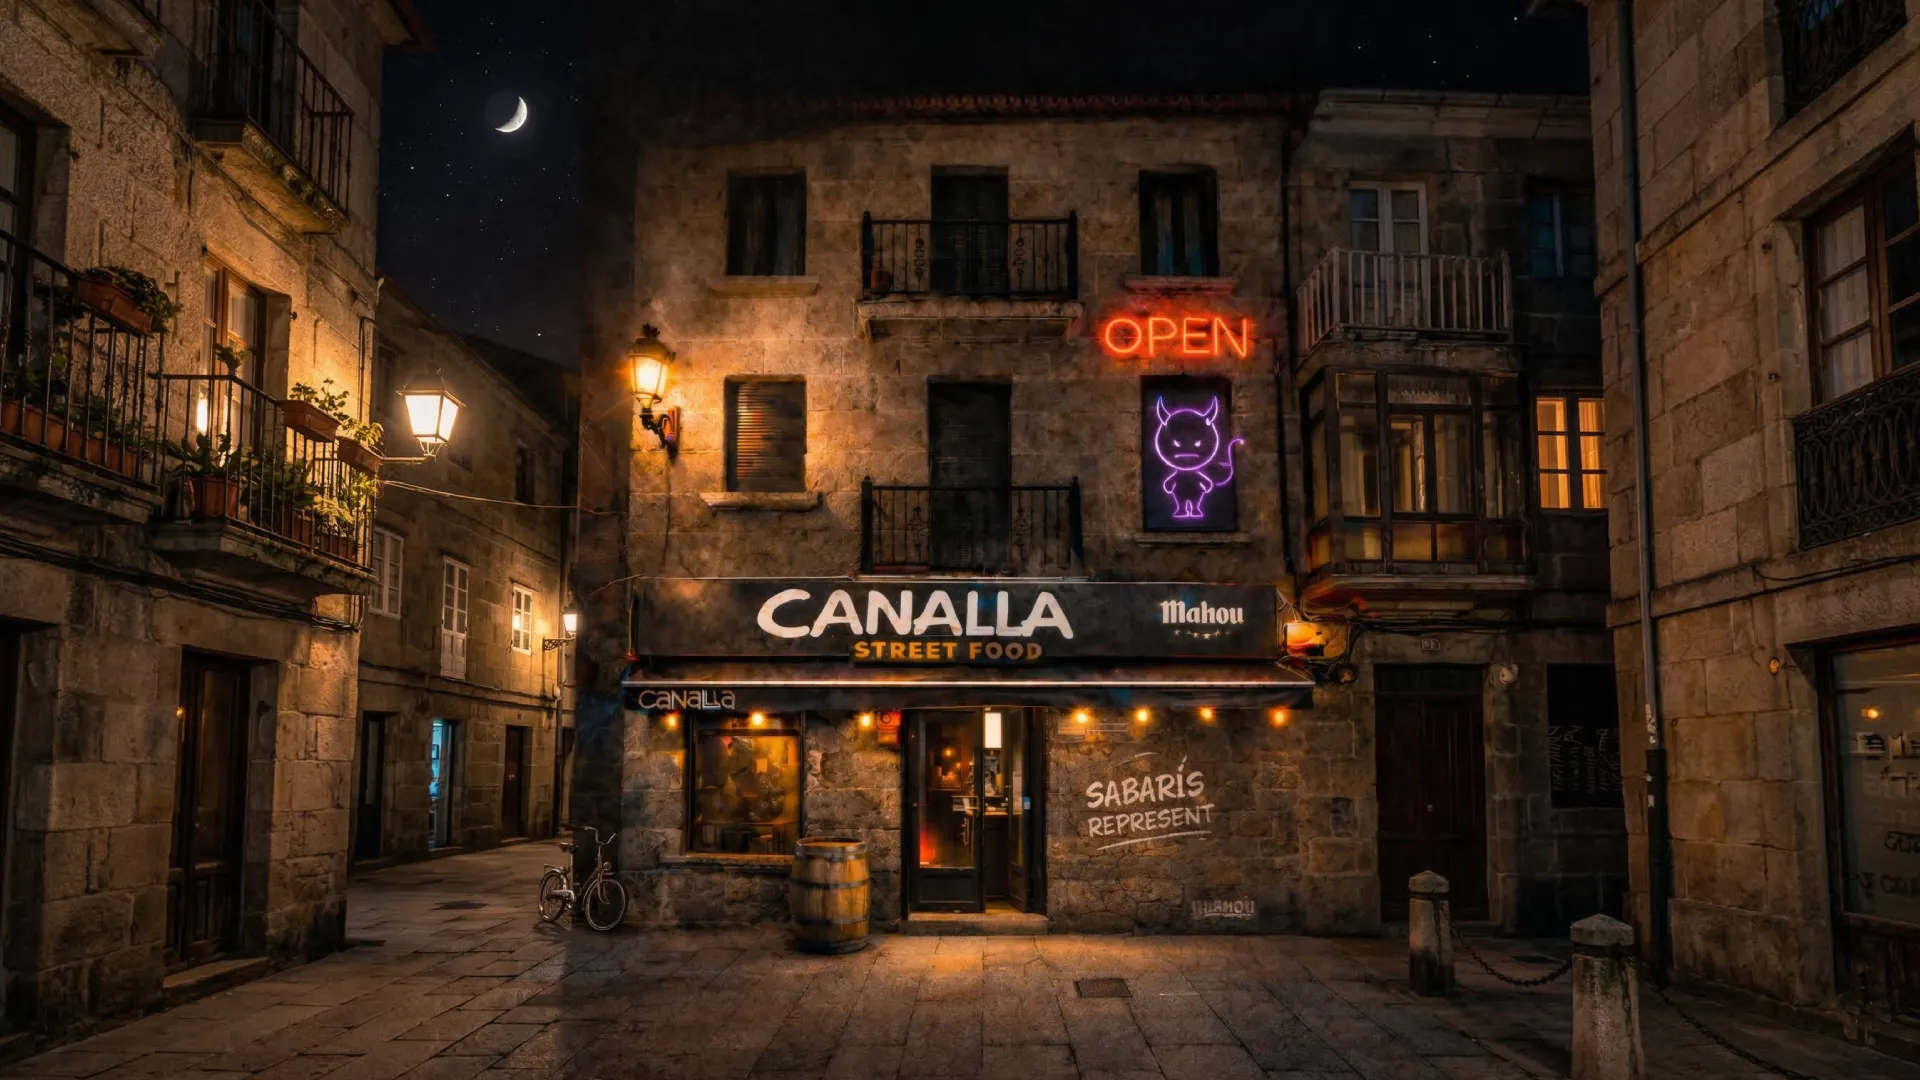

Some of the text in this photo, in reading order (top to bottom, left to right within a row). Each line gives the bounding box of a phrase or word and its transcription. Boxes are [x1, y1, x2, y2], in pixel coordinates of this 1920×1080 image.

[1104, 316, 1248, 358] OPEN
[756, 588, 1074, 640] CANALLA
[1159, 599, 1245, 625] Mahou
[854, 640, 1043, 661] STREET FOOD
[1085, 755, 1205, 809] SABARÍS
[1087, 803, 1216, 838] REPRESENT
